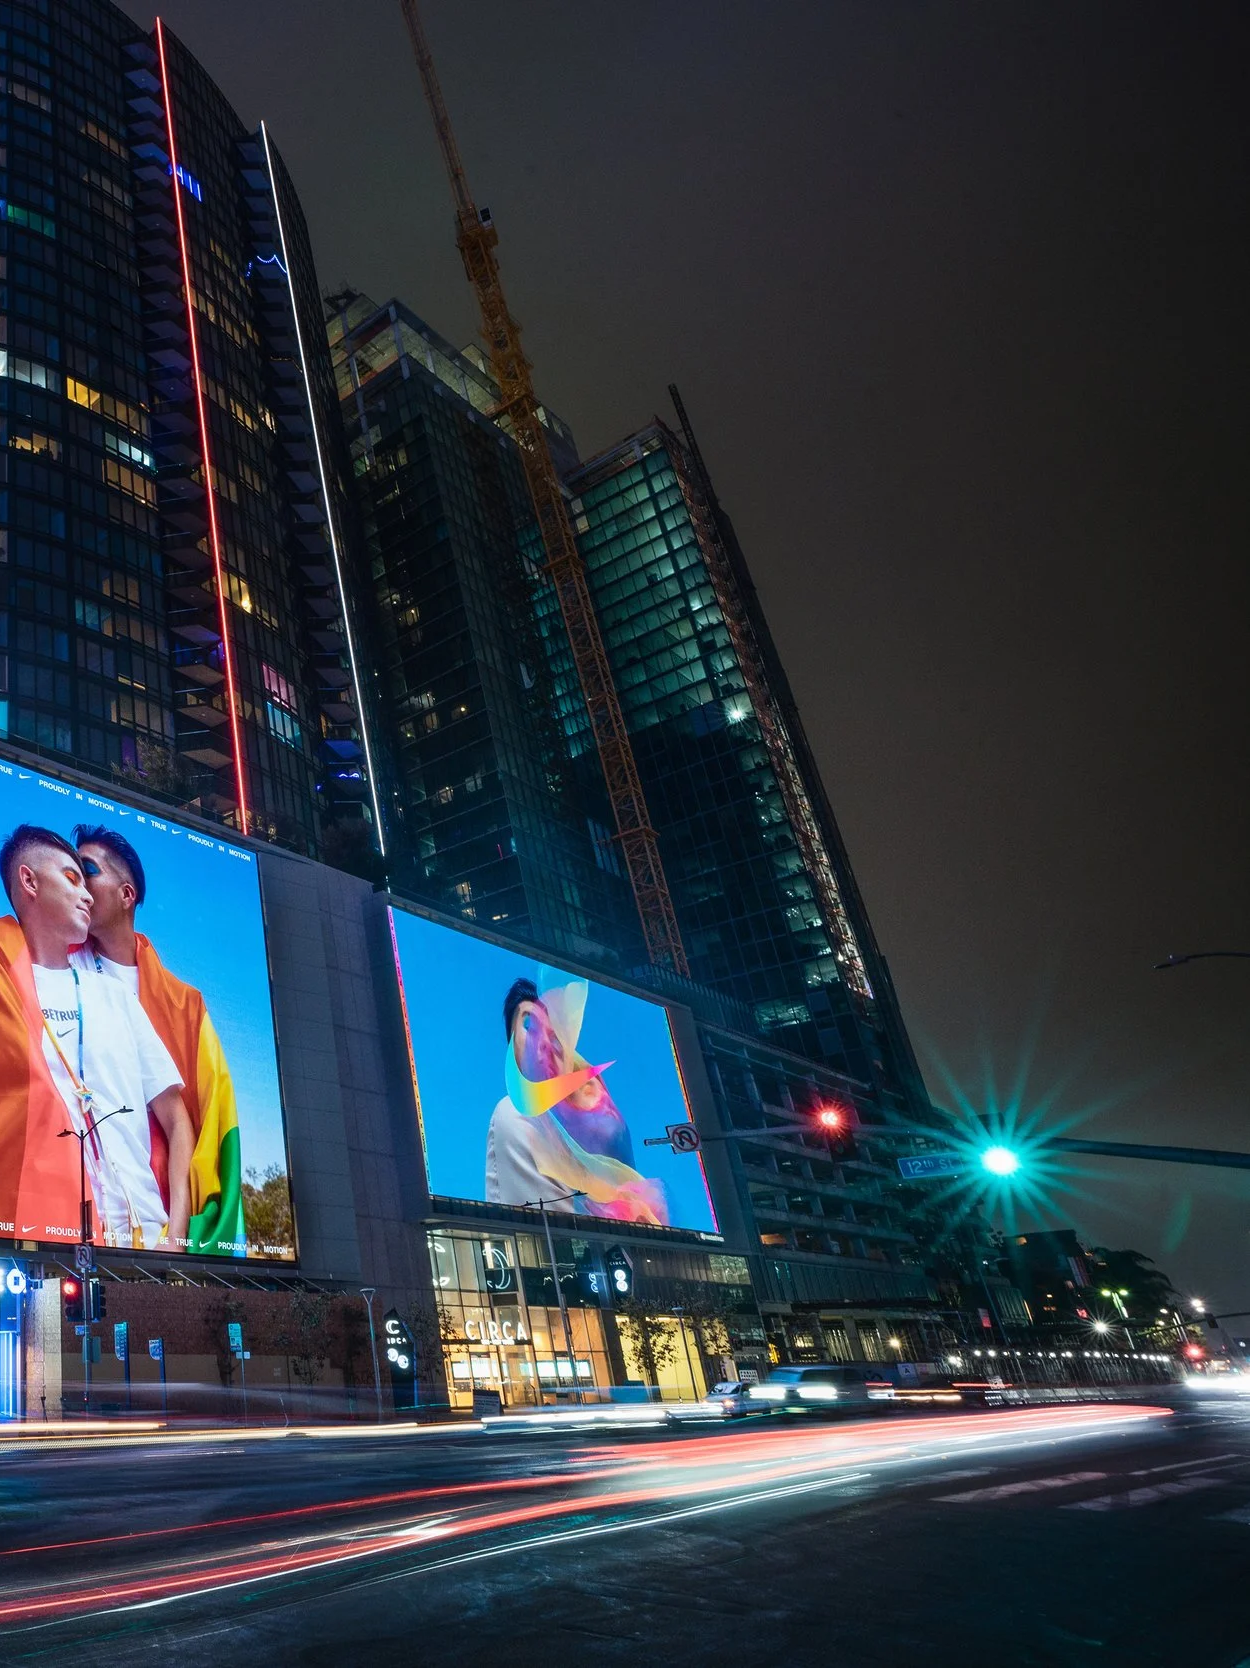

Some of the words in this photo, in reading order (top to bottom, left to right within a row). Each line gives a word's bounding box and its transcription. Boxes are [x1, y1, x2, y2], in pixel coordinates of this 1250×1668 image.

[38, 778, 71, 797] PROUDLY
[75, 792, 83, 801] IN
[88, 796, 115, 813] MOTION
[137, 815, 146, 824] BE
[150, 820, 167, 832] TRUE
[188, 833, 215, 850] PROUDLY
[228, 848, 251, 863] MOTION
[907, 1160, 934, 1175] 12th
[45, 1225, 82, 1239] PROUDLY
[103, 1231, 133, 1242] MOTION
[160, 1236, 169, 1246] BE
[175, 1237, 194, 1248] TRUE
[217, 1241, 247, 1252] PROUDLY
[252, 1243, 259, 1252] IN
[263, 1245, 288, 1255] MOTION
[464, 1319, 528, 1341] CIRCA
